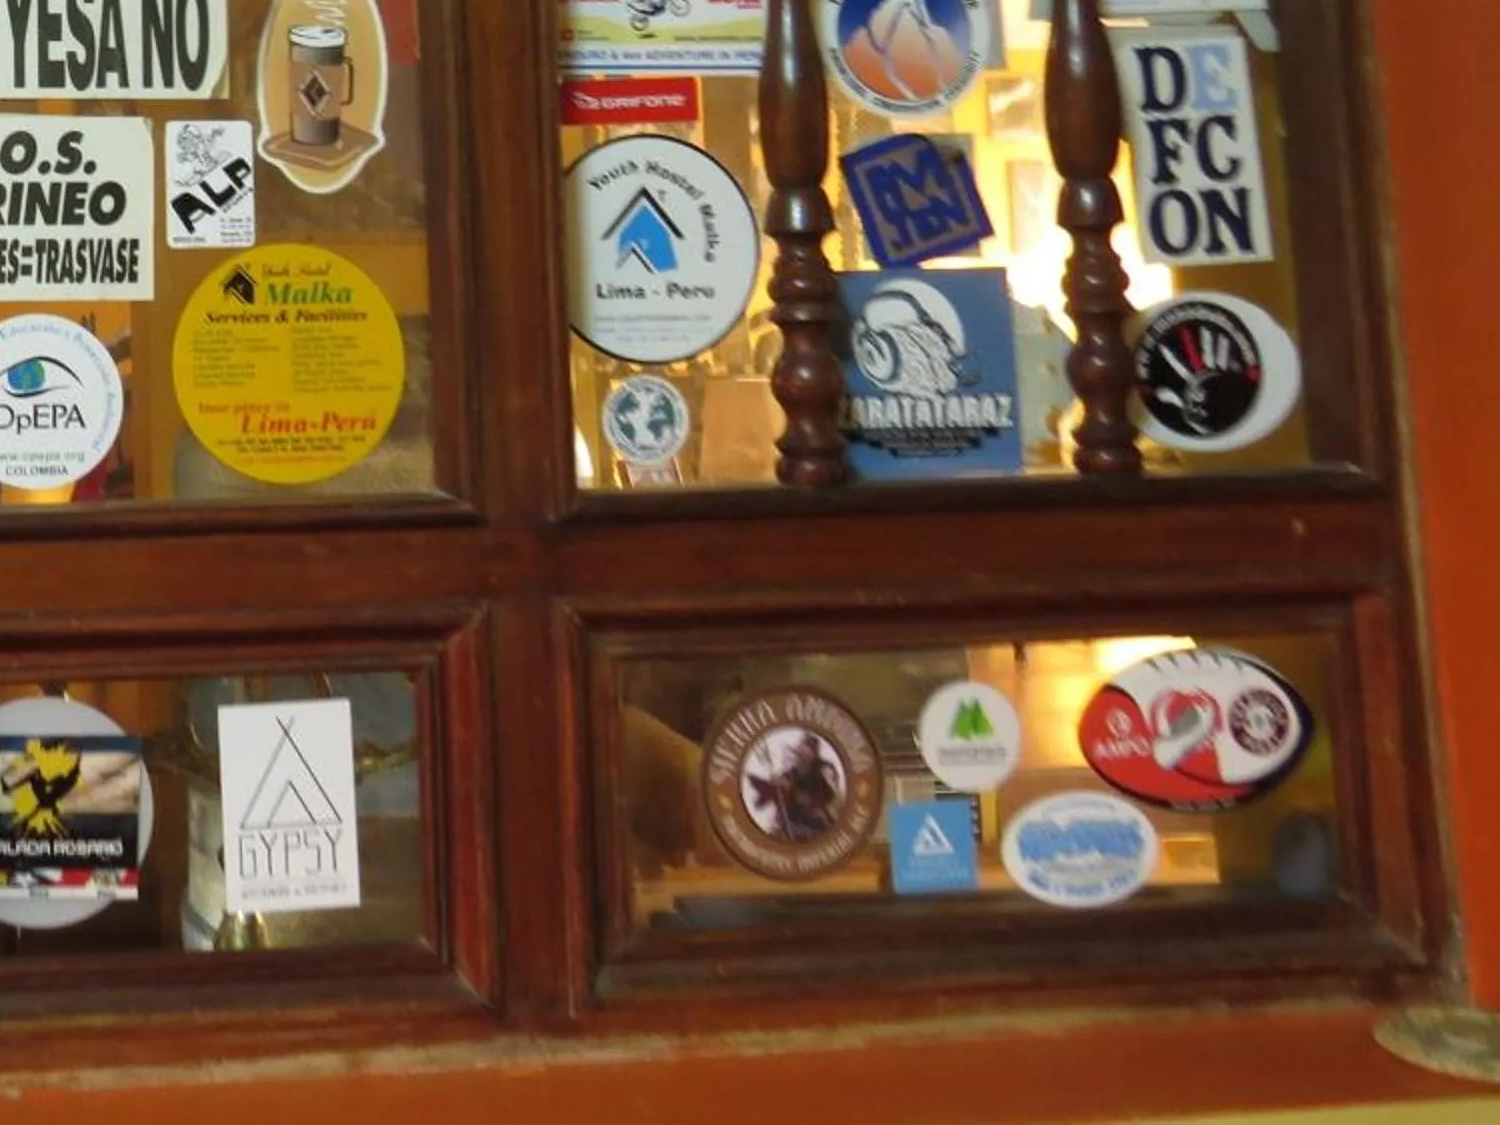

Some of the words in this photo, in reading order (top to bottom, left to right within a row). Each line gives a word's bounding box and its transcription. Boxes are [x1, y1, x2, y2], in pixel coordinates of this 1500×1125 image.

[265, 282, 353, 305] Malka
[596, 284, 647, 300] Lima
[5, 465, 69, 476] COLOMBIA
[238, 826, 344, 878] GYPSY
